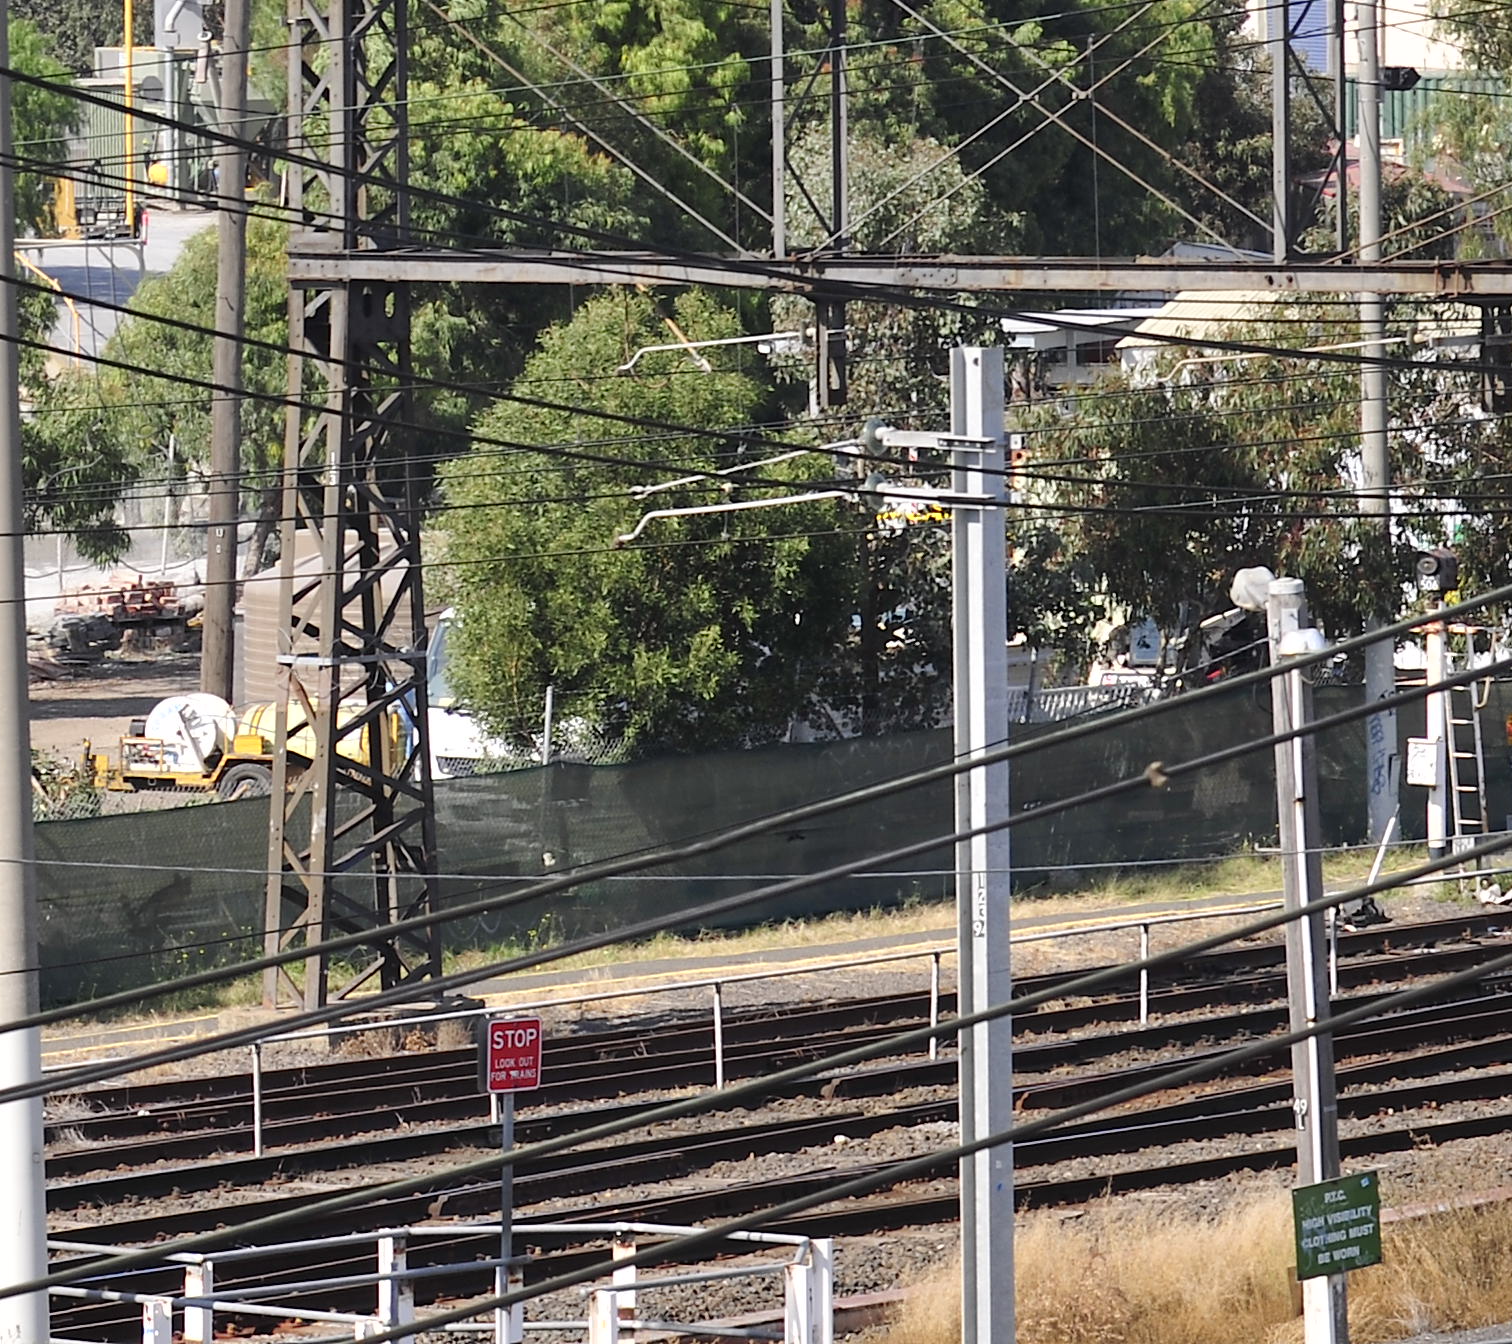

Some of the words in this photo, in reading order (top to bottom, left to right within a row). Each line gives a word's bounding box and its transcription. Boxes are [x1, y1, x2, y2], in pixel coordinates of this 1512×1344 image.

[492, 1028, 538, 1050] STOP
[495, 1057, 516, 1069] LOOK
[519, 1056, 534, 1067] OUT
[491, 1071, 507, 1082] FOR
[1301, 1214, 1325, 1230] HIGH
[1326, 1204, 1373, 1225] VISIBILITY
[1301, 1230, 1347, 1248] CLOTHING
[1348, 1223, 1375, 1239] MUST
[1317, 1251, 1331, 1265] BE
[1332, 1245, 1361, 1261] WORN
